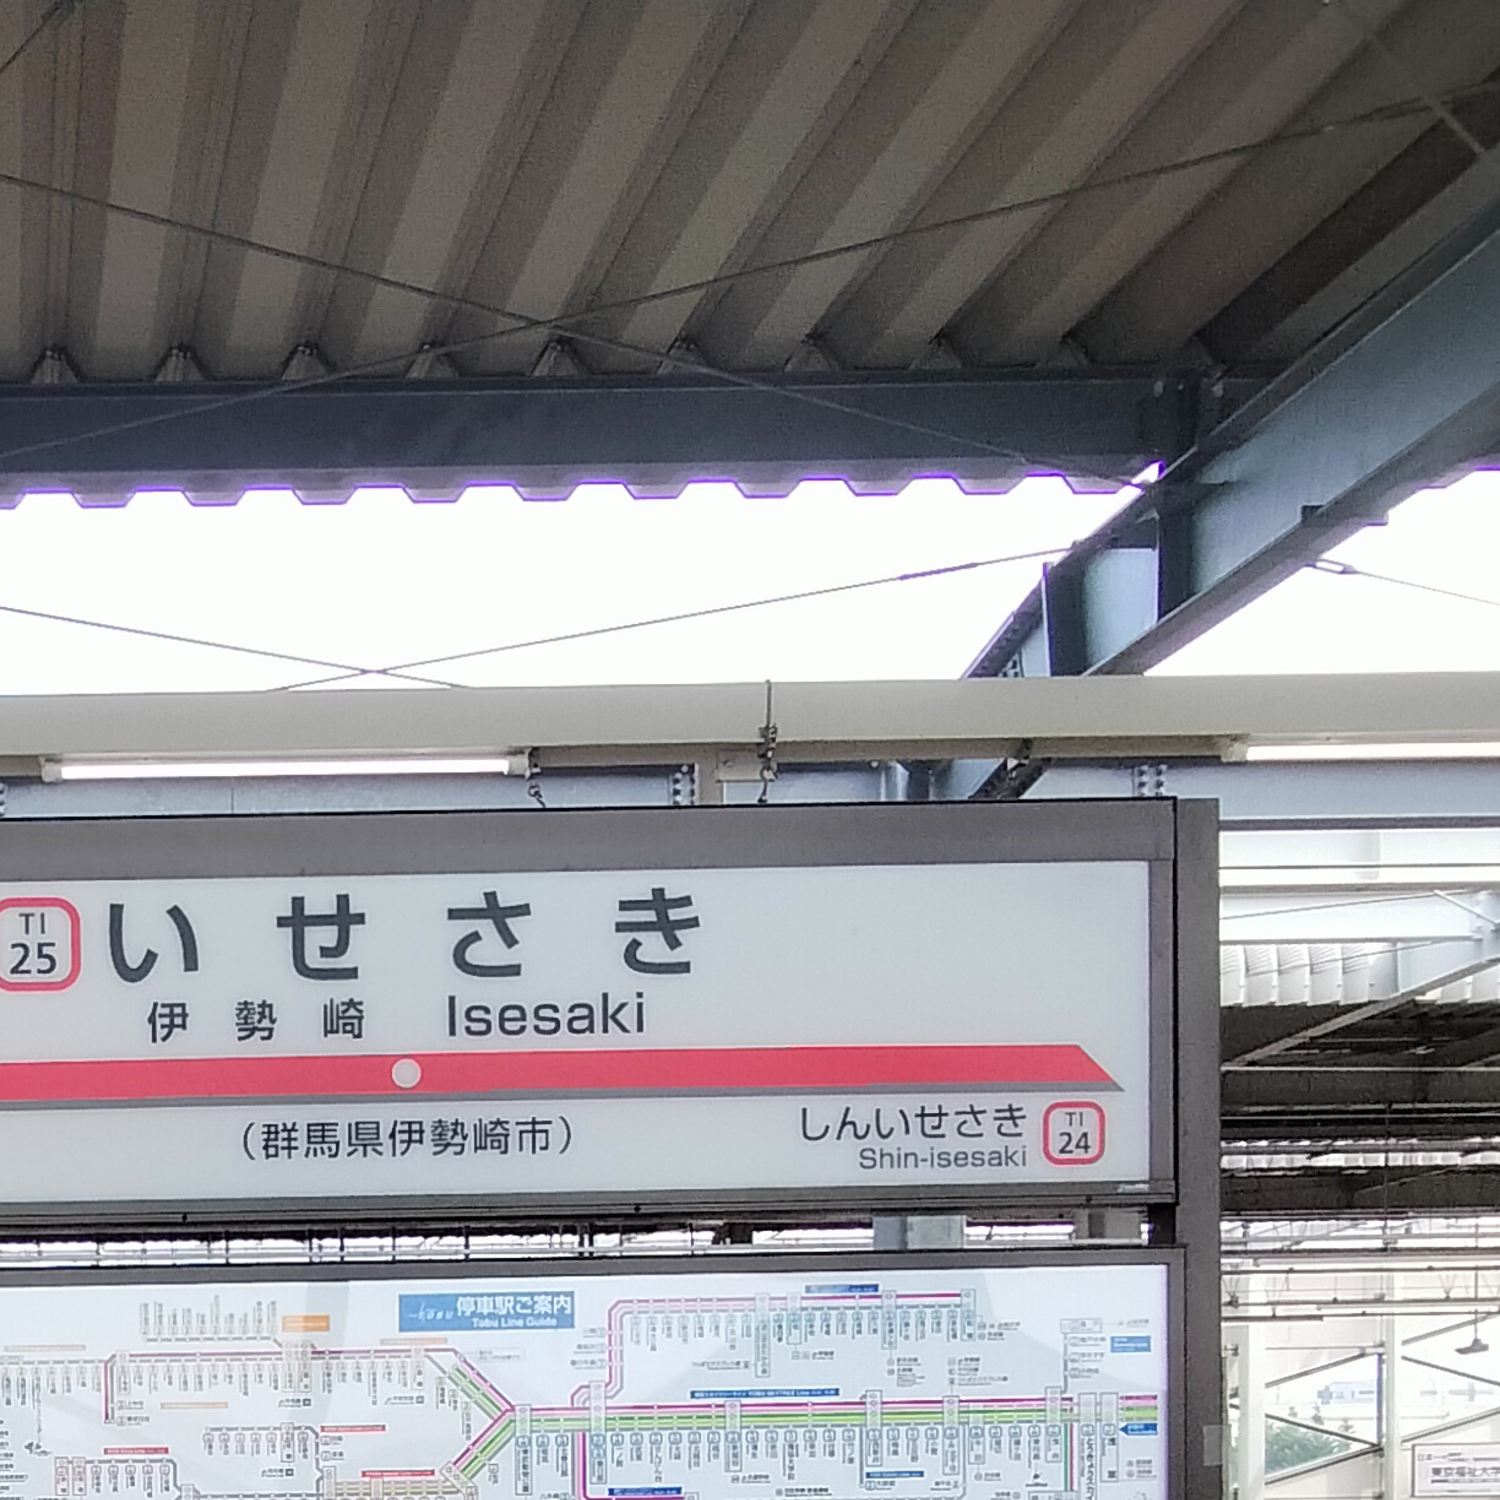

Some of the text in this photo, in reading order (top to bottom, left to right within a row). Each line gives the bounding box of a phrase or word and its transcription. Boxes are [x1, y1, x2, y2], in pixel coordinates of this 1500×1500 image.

[10, 906, 52, 935] TI
[109, 888, 700, 983] いせさき
[2, 943, 56, 980] 25
[148, 998, 364, 1043] 伊勢崎
[449, 992, 643, 1036] Isesaki
[802, 1104, 1026, 1141] しんいせさき
[1065, 1112, 1083, 1127] TI
[244, 1116, 571, 1160] （群馬県伊勢崎市）
[1059, 1132, 1091, 1154] 24
[860, 1145, 1026, 1169] Shin-isesaki
[456, 1294, 572, 1316] 停車駅ご案内
[472, 1316, 558, 1328] Tobu Line Guide
